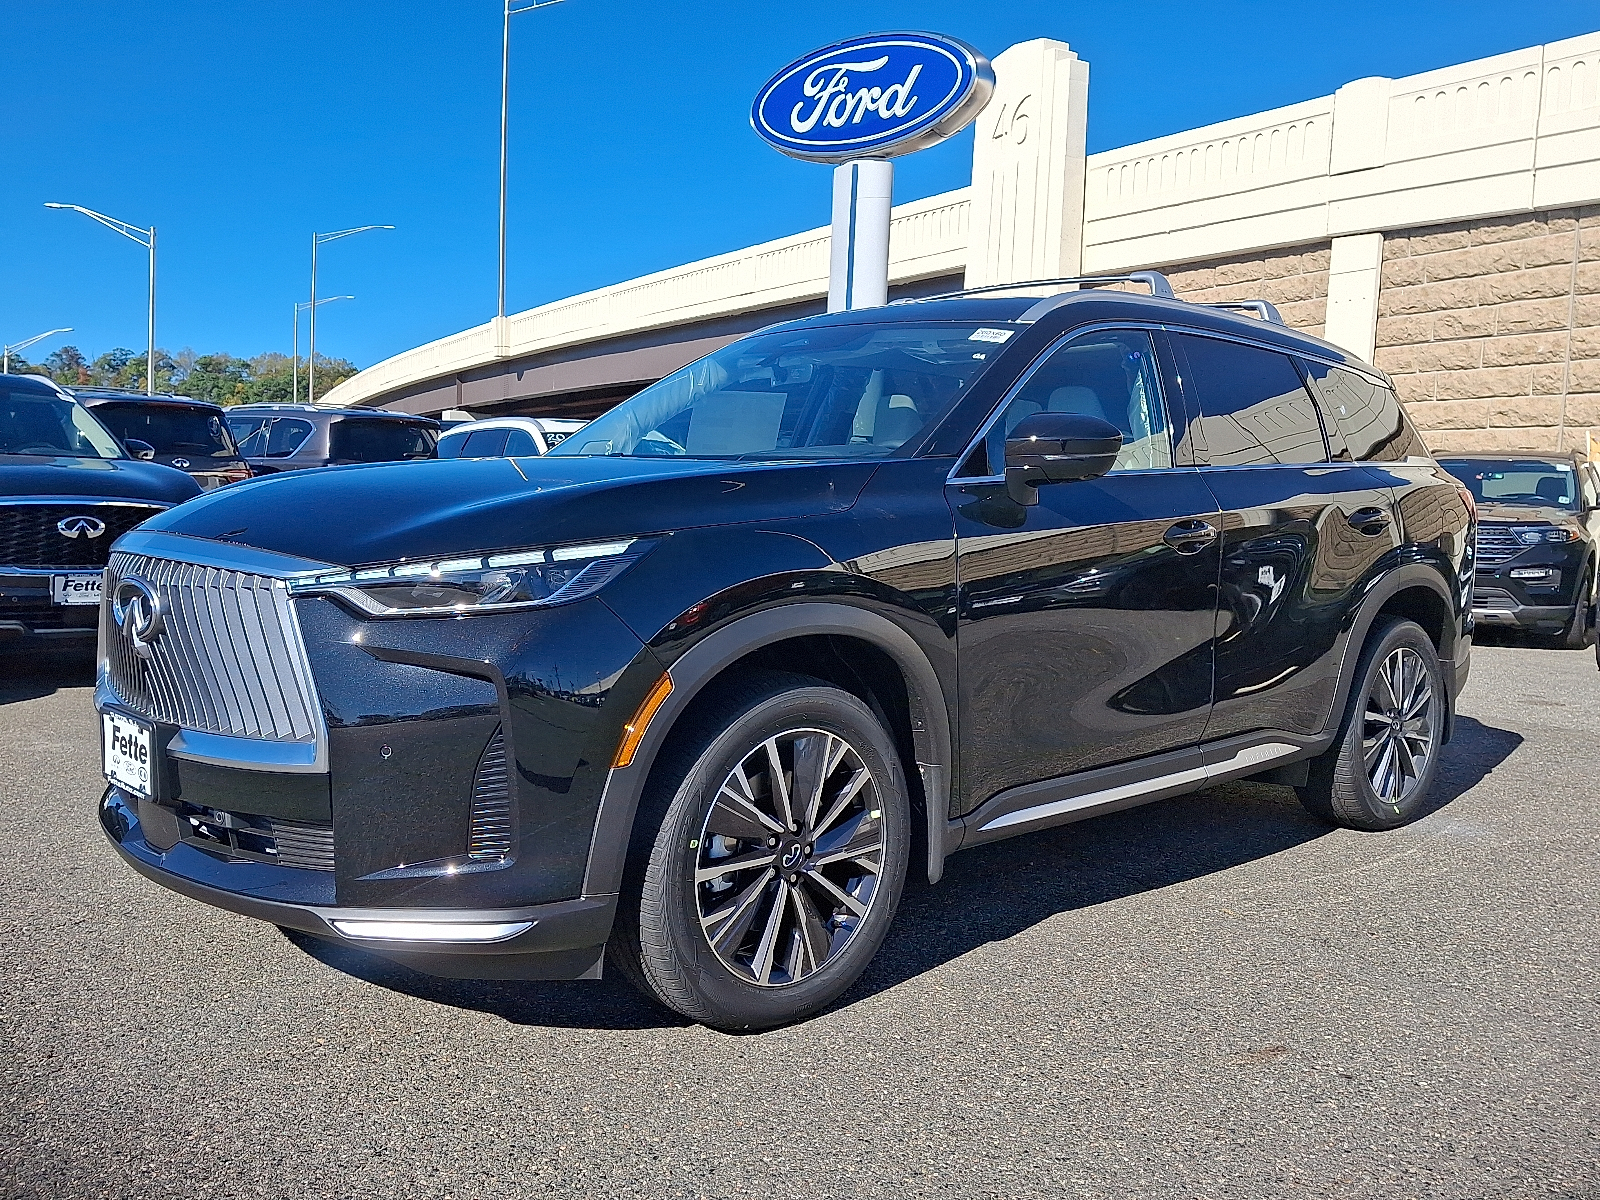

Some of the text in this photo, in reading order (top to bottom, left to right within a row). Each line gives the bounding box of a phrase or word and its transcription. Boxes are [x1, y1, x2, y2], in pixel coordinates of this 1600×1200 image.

[790, 55, 924, 134] Ford
[992, 94, 1031, 145] 46
[62, 580, 103, 592] Fette
[112, 724, 148, 765] Fette
